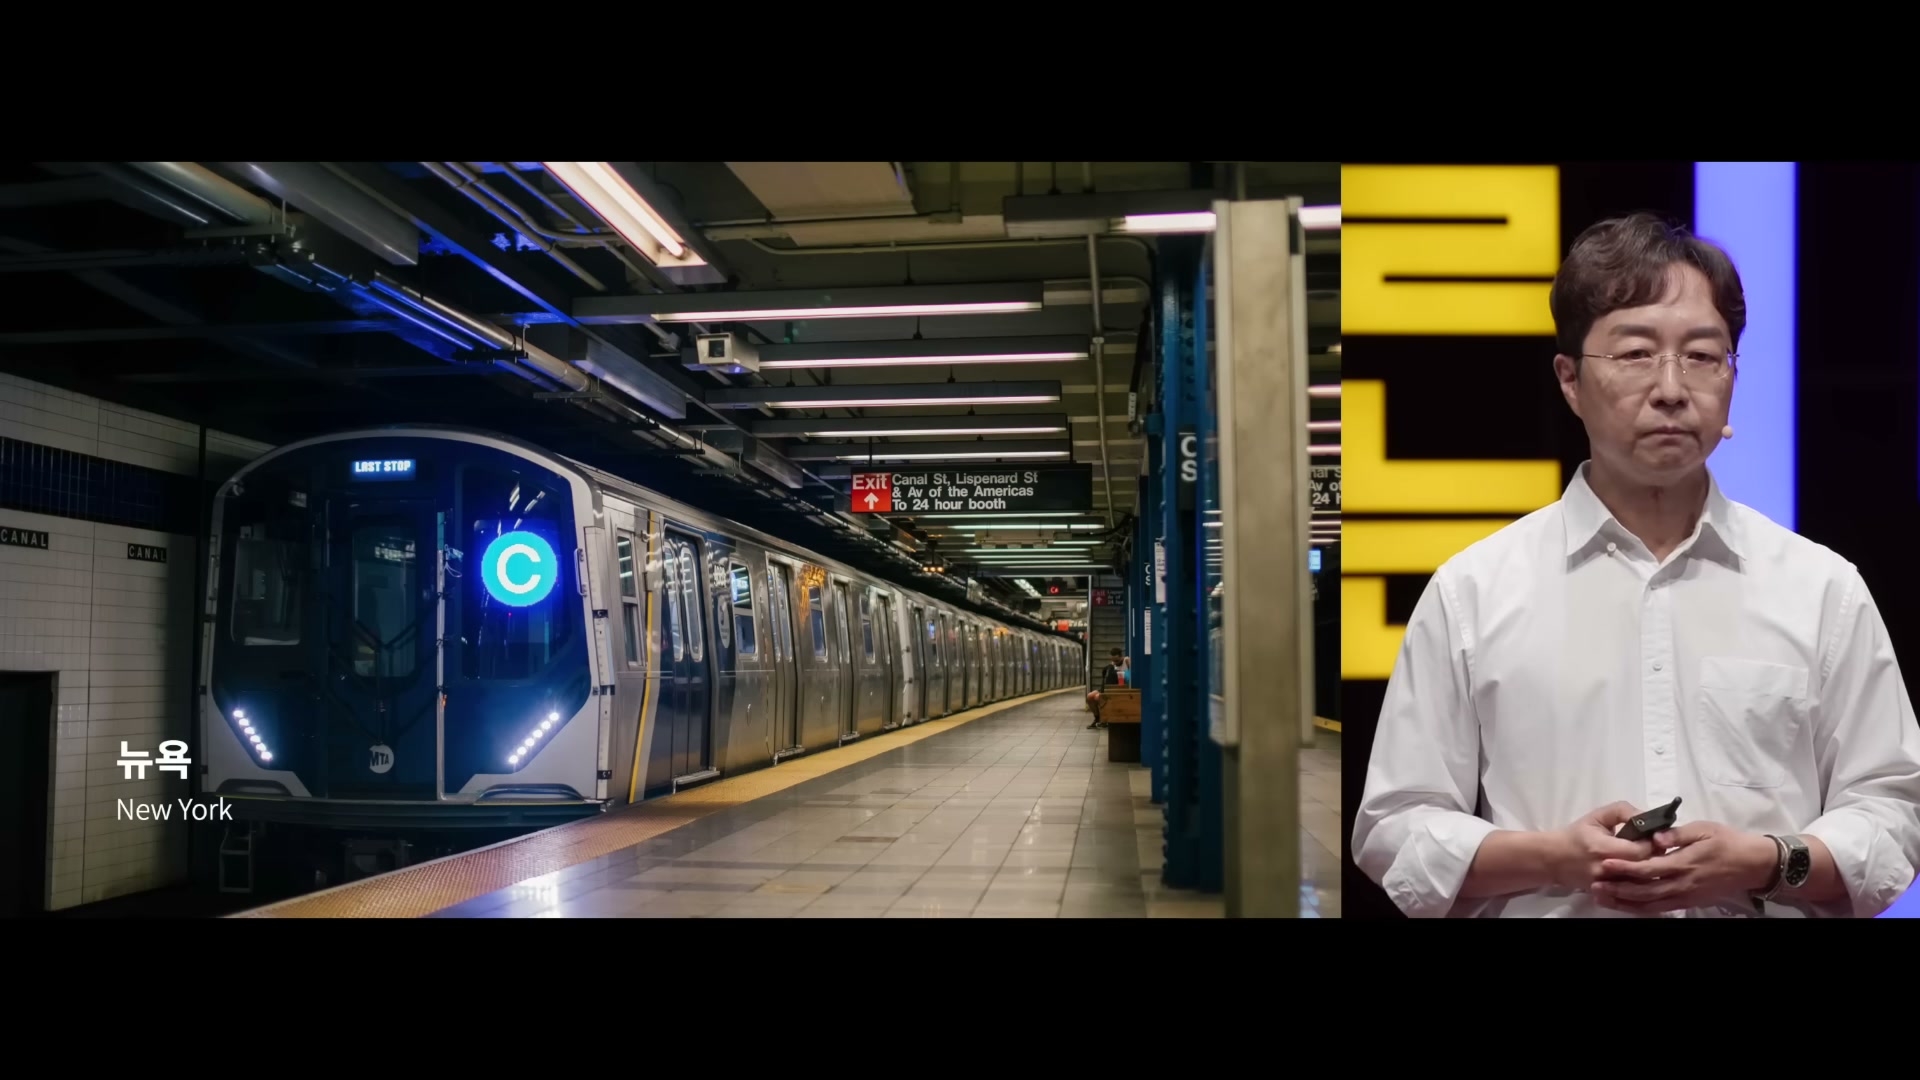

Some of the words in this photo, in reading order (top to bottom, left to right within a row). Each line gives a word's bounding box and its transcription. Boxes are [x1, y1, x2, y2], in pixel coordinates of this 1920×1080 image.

[355, 461, 382, 473] LAST
[383, 460, 411, 472] STOP
[852, 474, 888, 490] Exit
[892, 473, 928, 486] Canal
[933, 473, 951, 487] St,
[956, 472, 1018, 487] Lispenard
[1023, 471, 1038, 484] St
[892, 486, 902, 498] &
[907, 486, 923, 498] Av
[928, 486, 942, 498] of
[947, 485, 968, 497] the
[973, 485, 1034, 497] Americas
[1312, 492, 1330, 505] 24
[892, 498, 907, 511] To
[912, 498, 929, 511] 24
[935, 498, 963, 511] hour
[968, 497, 1006, 510] booth
[0, 530, 47, 547] CANAL
[128, 545, 166, 562] CANAL
[496, 543, 541, 594] C
[370, 751, 390, 767] MTA
